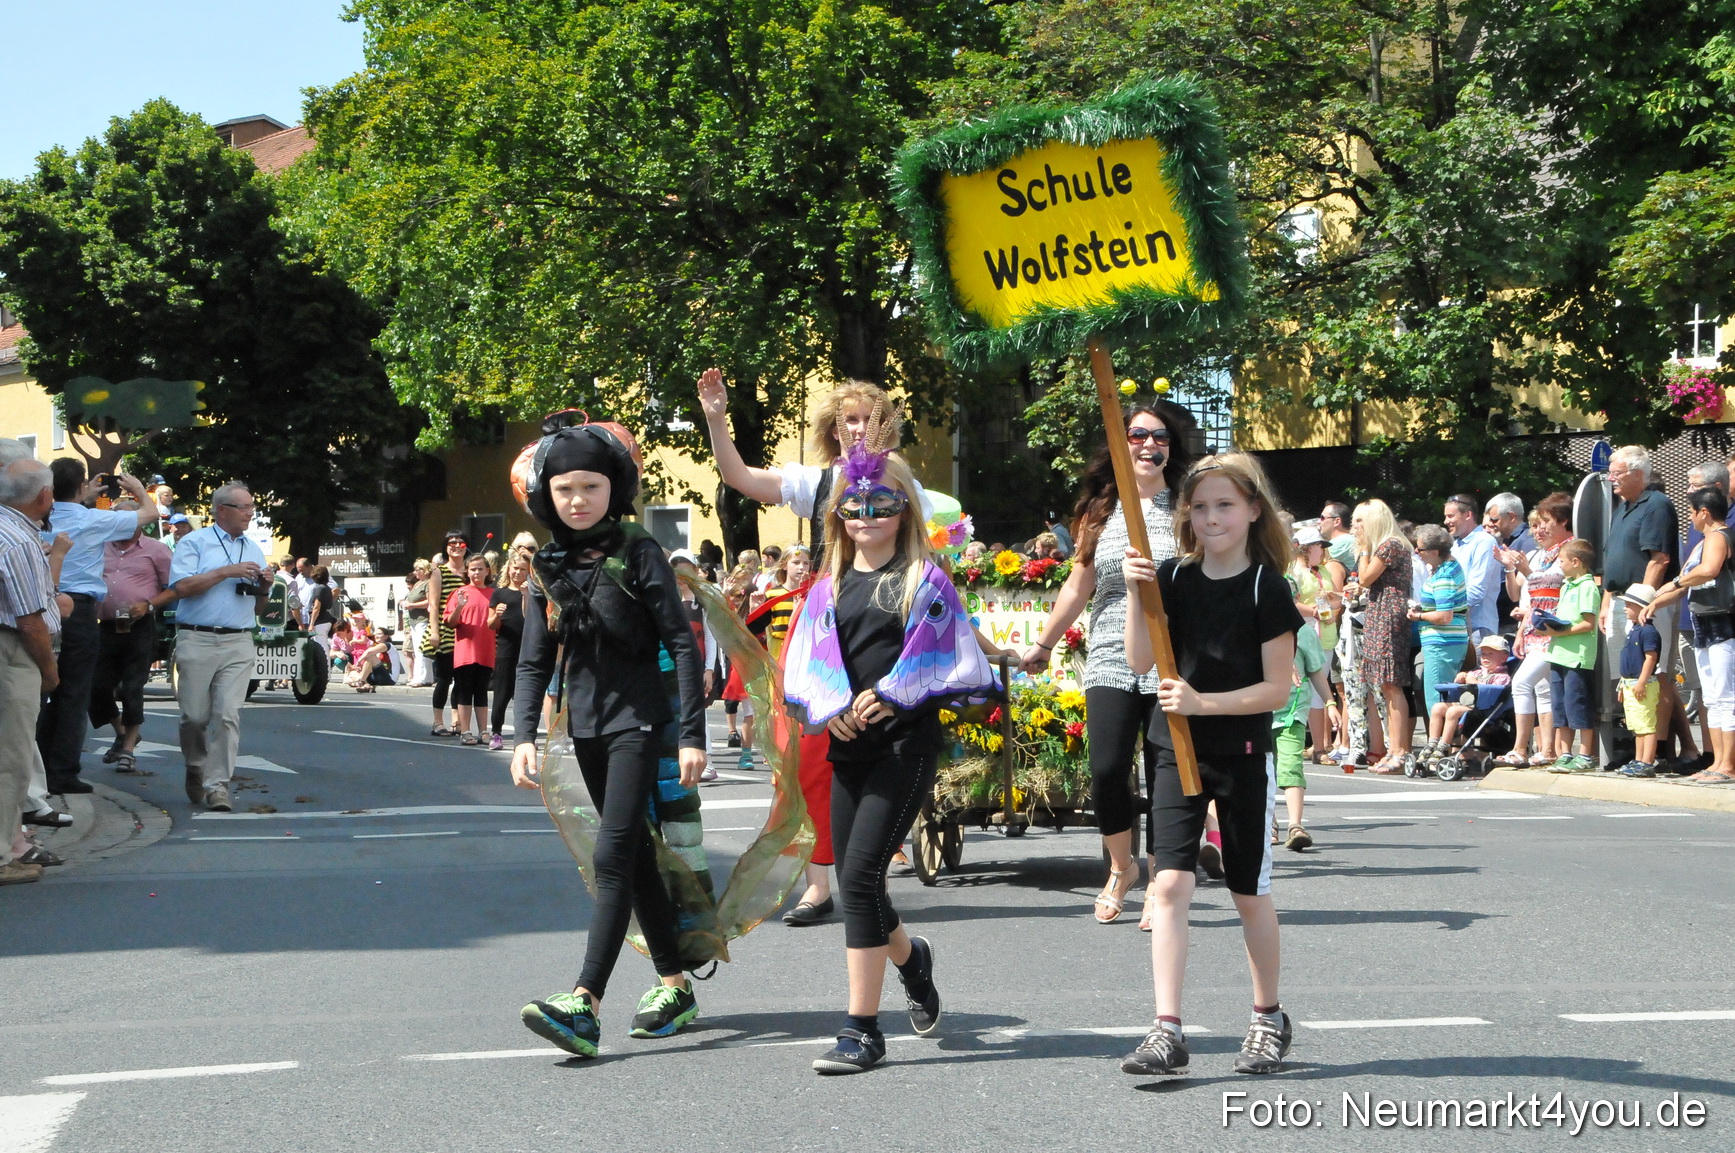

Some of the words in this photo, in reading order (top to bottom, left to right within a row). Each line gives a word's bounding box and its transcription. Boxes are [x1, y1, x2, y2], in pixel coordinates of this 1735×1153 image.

[997, 156, 1133, 217] Schule
[983, 222, 1177, 291] Wolfstein
[318, 542, 347, 556] sfahrt
[351, 541, 368, 557] Tag
[376, 540, 405, 554] Nacht
[331, 559, 380, 573] freihalten!
[966, 592, 995, 612] Die
[991, 620, 1045, 645] Welt
[256, 645, 297, 657] chule
[256, 659, 298, 679] ölling
